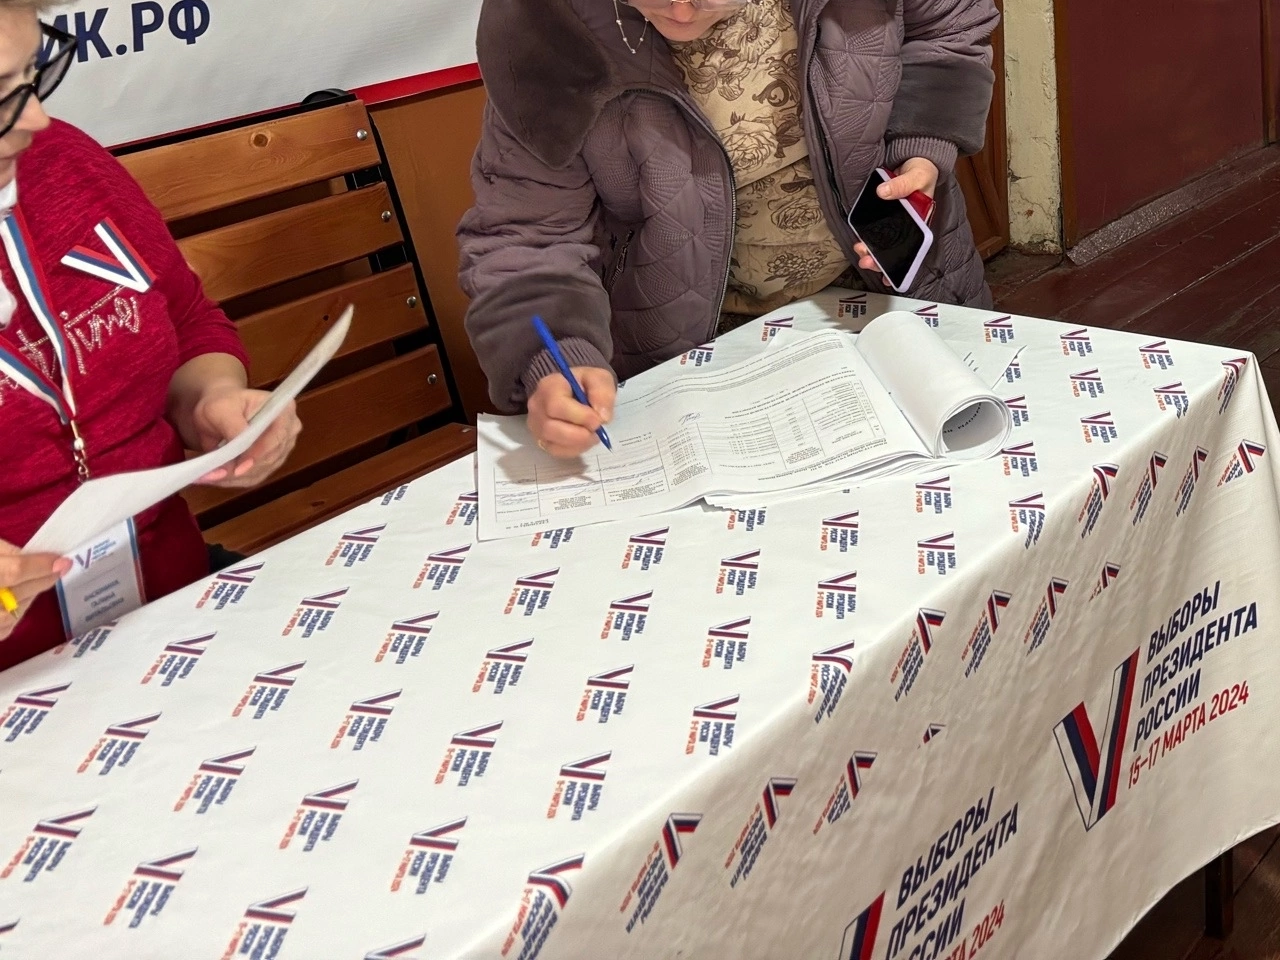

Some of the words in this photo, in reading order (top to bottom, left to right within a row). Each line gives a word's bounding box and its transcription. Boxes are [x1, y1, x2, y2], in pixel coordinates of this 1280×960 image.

[1140, 602, 1258, 709] ПРЕЗИДЕНТА
[1147, 580, 1221, 665] ВЫБОРЫ
[1133, 668, 1202, 752] РОССИИ
[1162, 702, 1206, 758] МАРТА
[1209, 680, 1249, 722] 2024
[886, 802, 1019, 960] ПРЕЗИДЕНТА
[896, 786, 995, 911] ВЫБОРЫ
[908, 897, 966, 960] ССИИ
[969, 899, 1005, 959] 2024
